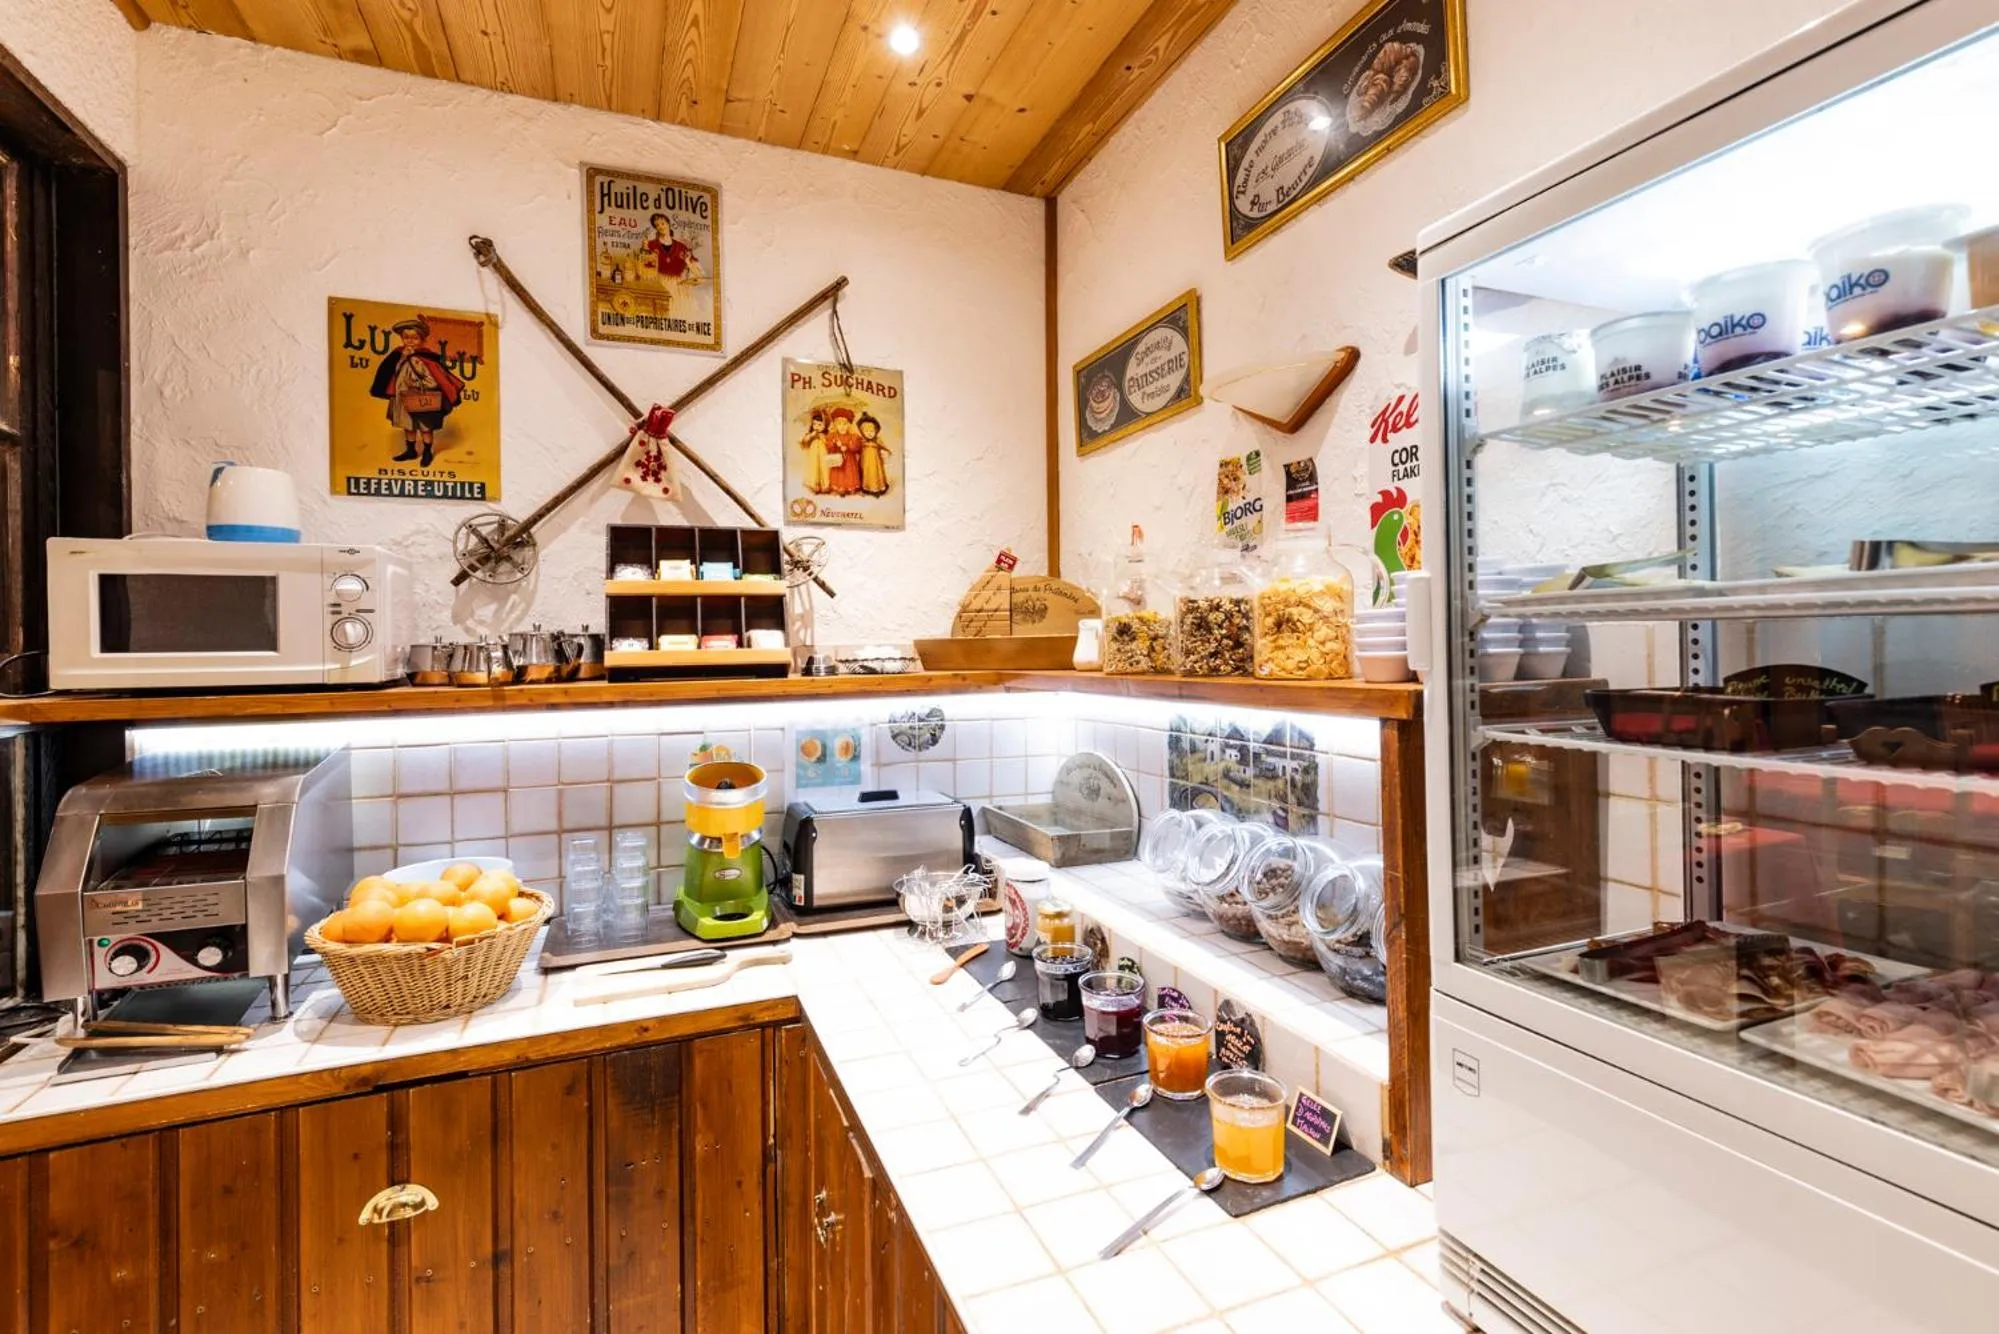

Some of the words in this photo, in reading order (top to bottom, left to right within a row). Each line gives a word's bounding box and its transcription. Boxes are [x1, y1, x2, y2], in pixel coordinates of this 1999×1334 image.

[598, 180, 650, 214] Huile
[653, 187, 709, 220] d'Olive
[608, 215, 638, 228] EAU
[601, 311, 625, 326] UNION
[696, 322, 711, 336] NICE
[349, 355, 369, 369] LU
[790, 372, 816, 390] PH.
[821, 370, 898, 399] SUCHARD
[1613, 371, 1652, 386] ALPES
[463, 389, 480, 401] LU
[377, 468, 457, 479] BISCUITS
[350, 478, 482, 498] LEFEVRE-UTILE
